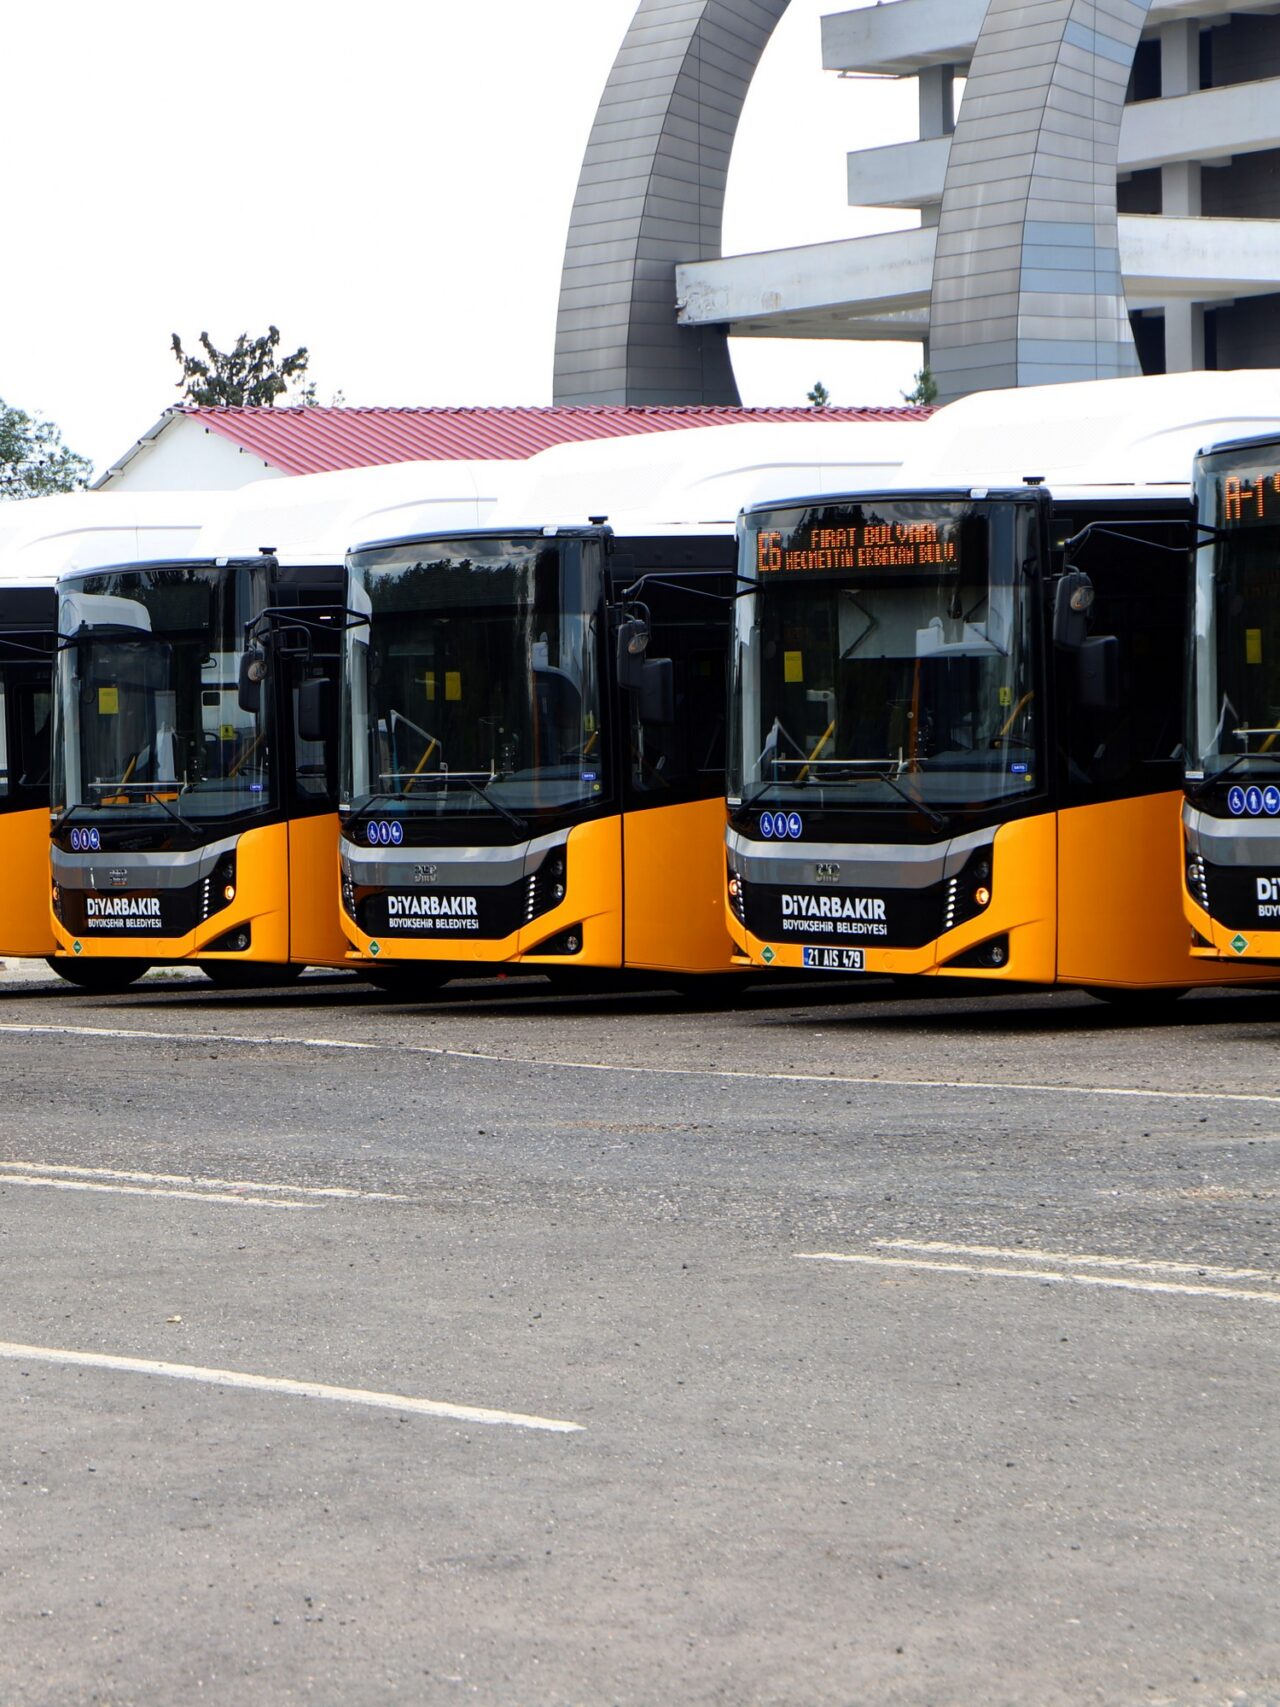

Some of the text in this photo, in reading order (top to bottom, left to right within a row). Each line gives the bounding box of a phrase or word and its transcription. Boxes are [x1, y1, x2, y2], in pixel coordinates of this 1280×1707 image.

[1225, 474, 1264, 519] A-1
[823, 949, 839, 967] AIS
[843, 951, 860, 968] 479
